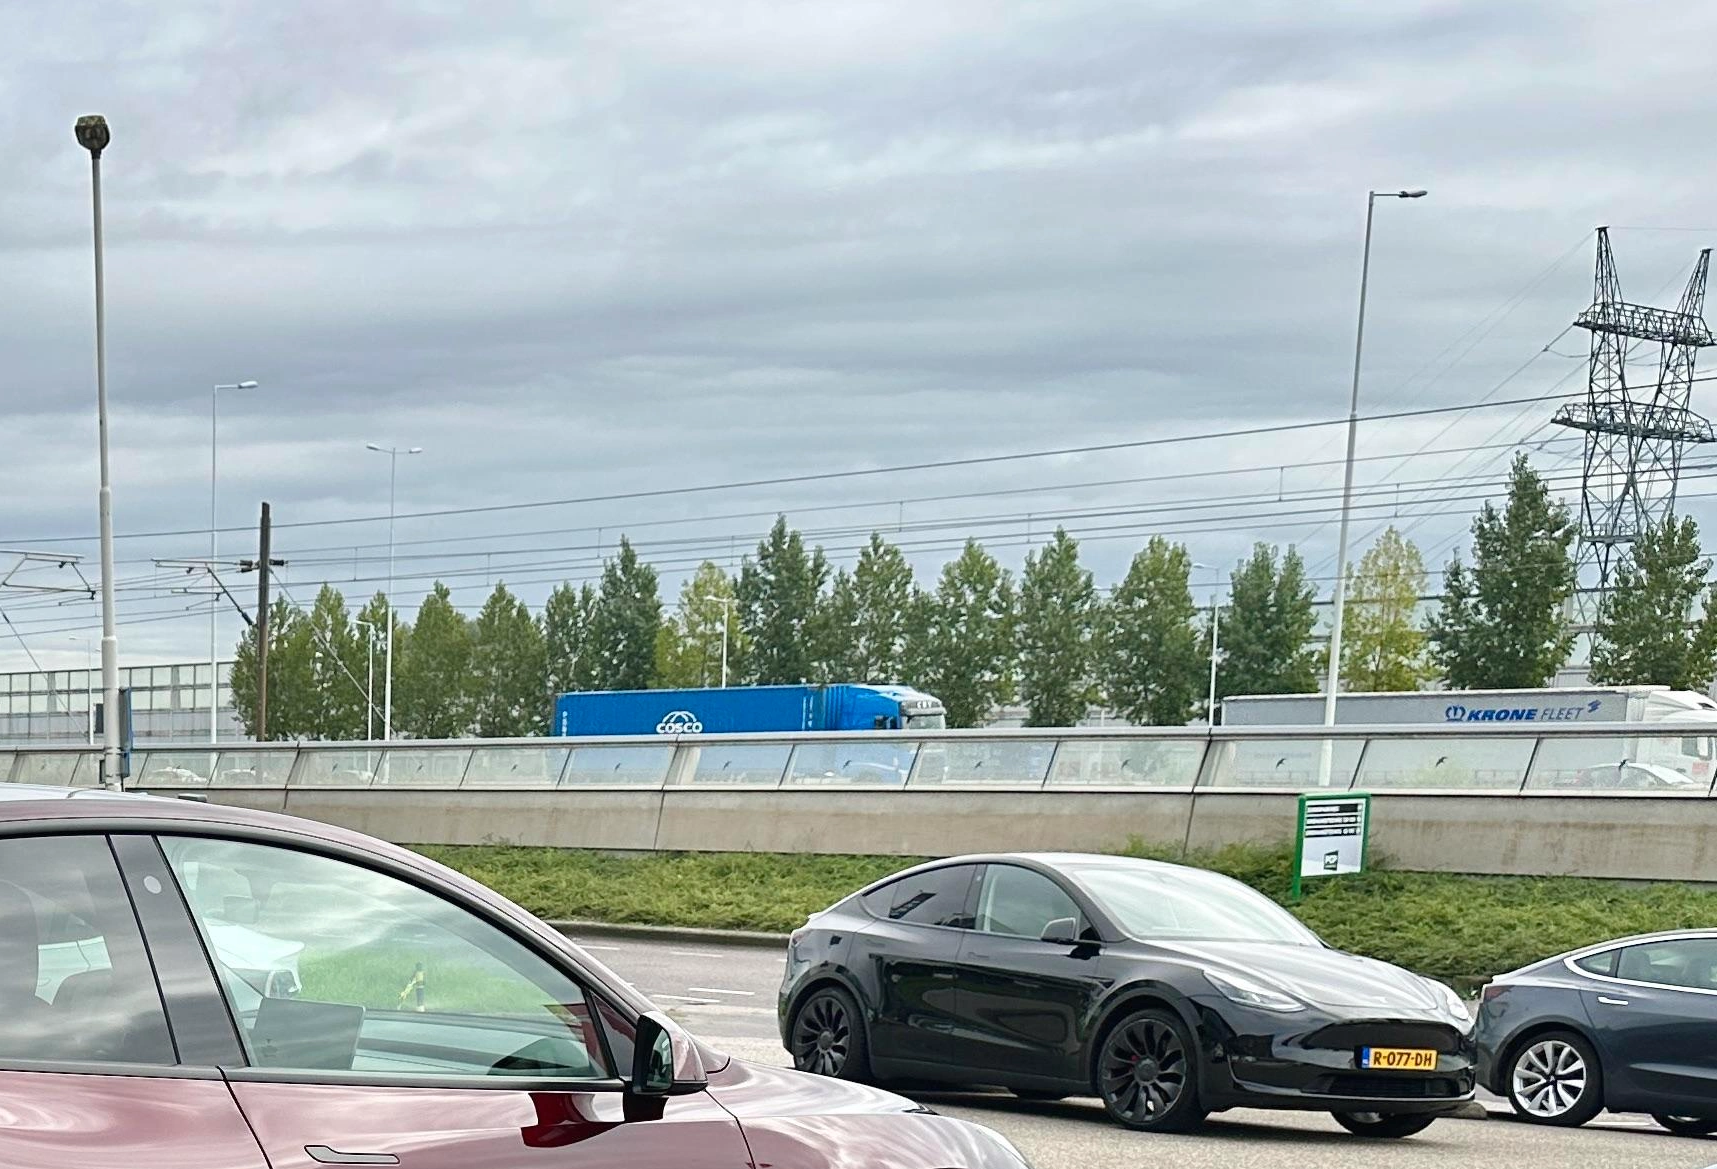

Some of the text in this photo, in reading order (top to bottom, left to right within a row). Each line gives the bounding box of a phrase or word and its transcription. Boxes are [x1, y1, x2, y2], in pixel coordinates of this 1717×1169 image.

[1467, 707, 1583, 722] KRONE FLEET
[656, 721, 703, 734] COSCO
[1373, 1051, 1432, 1067] R-077-DH
